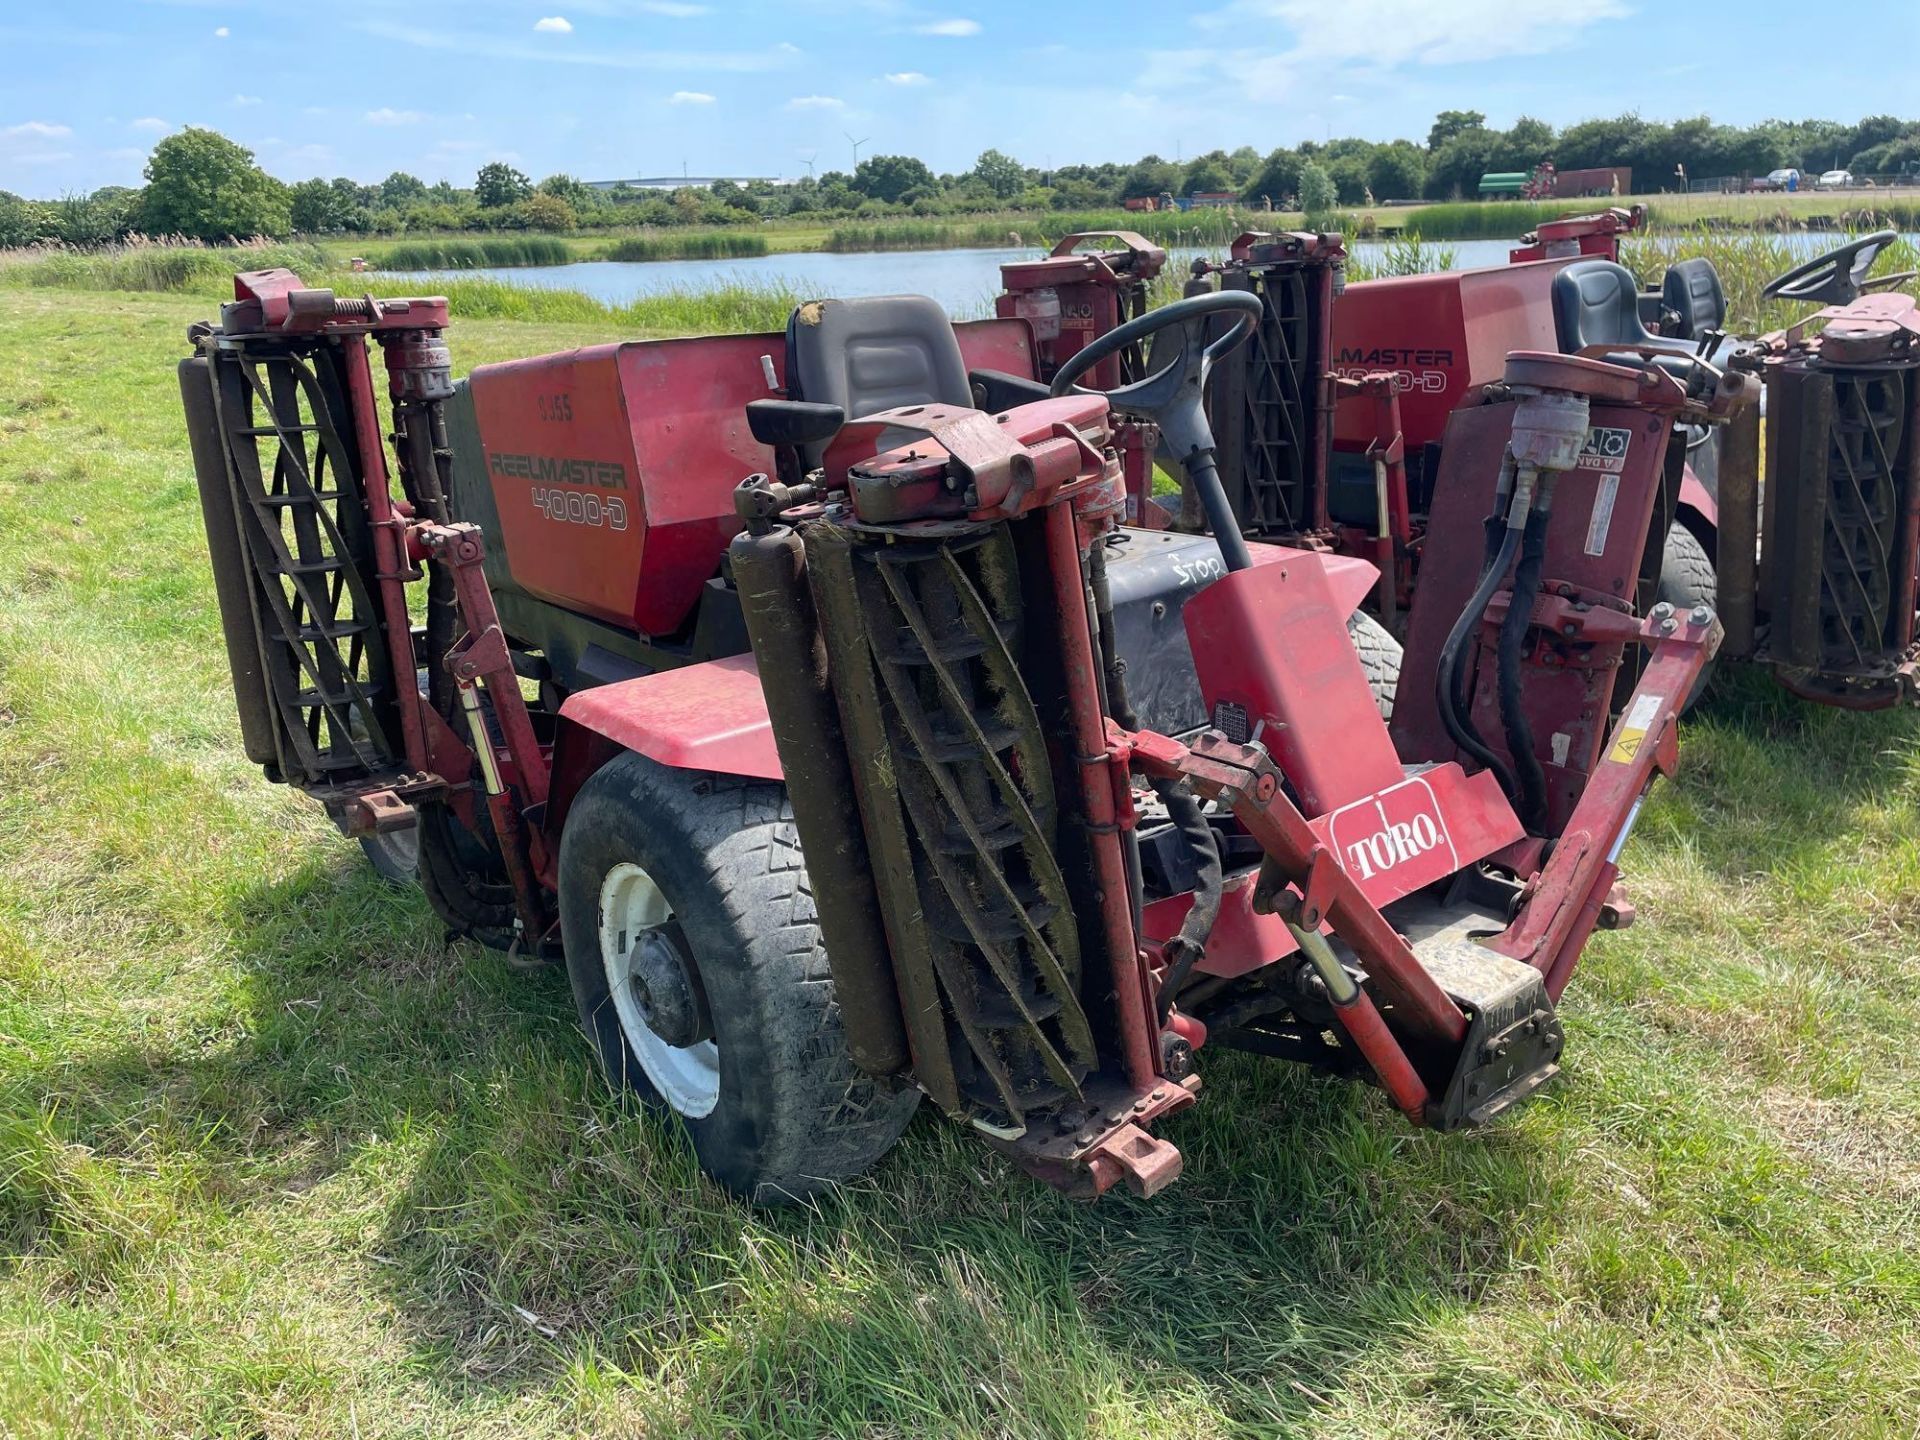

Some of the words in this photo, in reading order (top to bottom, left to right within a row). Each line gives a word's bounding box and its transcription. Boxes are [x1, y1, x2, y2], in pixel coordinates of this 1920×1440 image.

[1333, 347, 1454, 367] MASTER
[489, 452, 628, 490] REELMASTER
[1577, 456, 1602, 468] DAN
[531, 486, 628, 532] 4000-D
[1172, 557, 1221, 586] STOP
